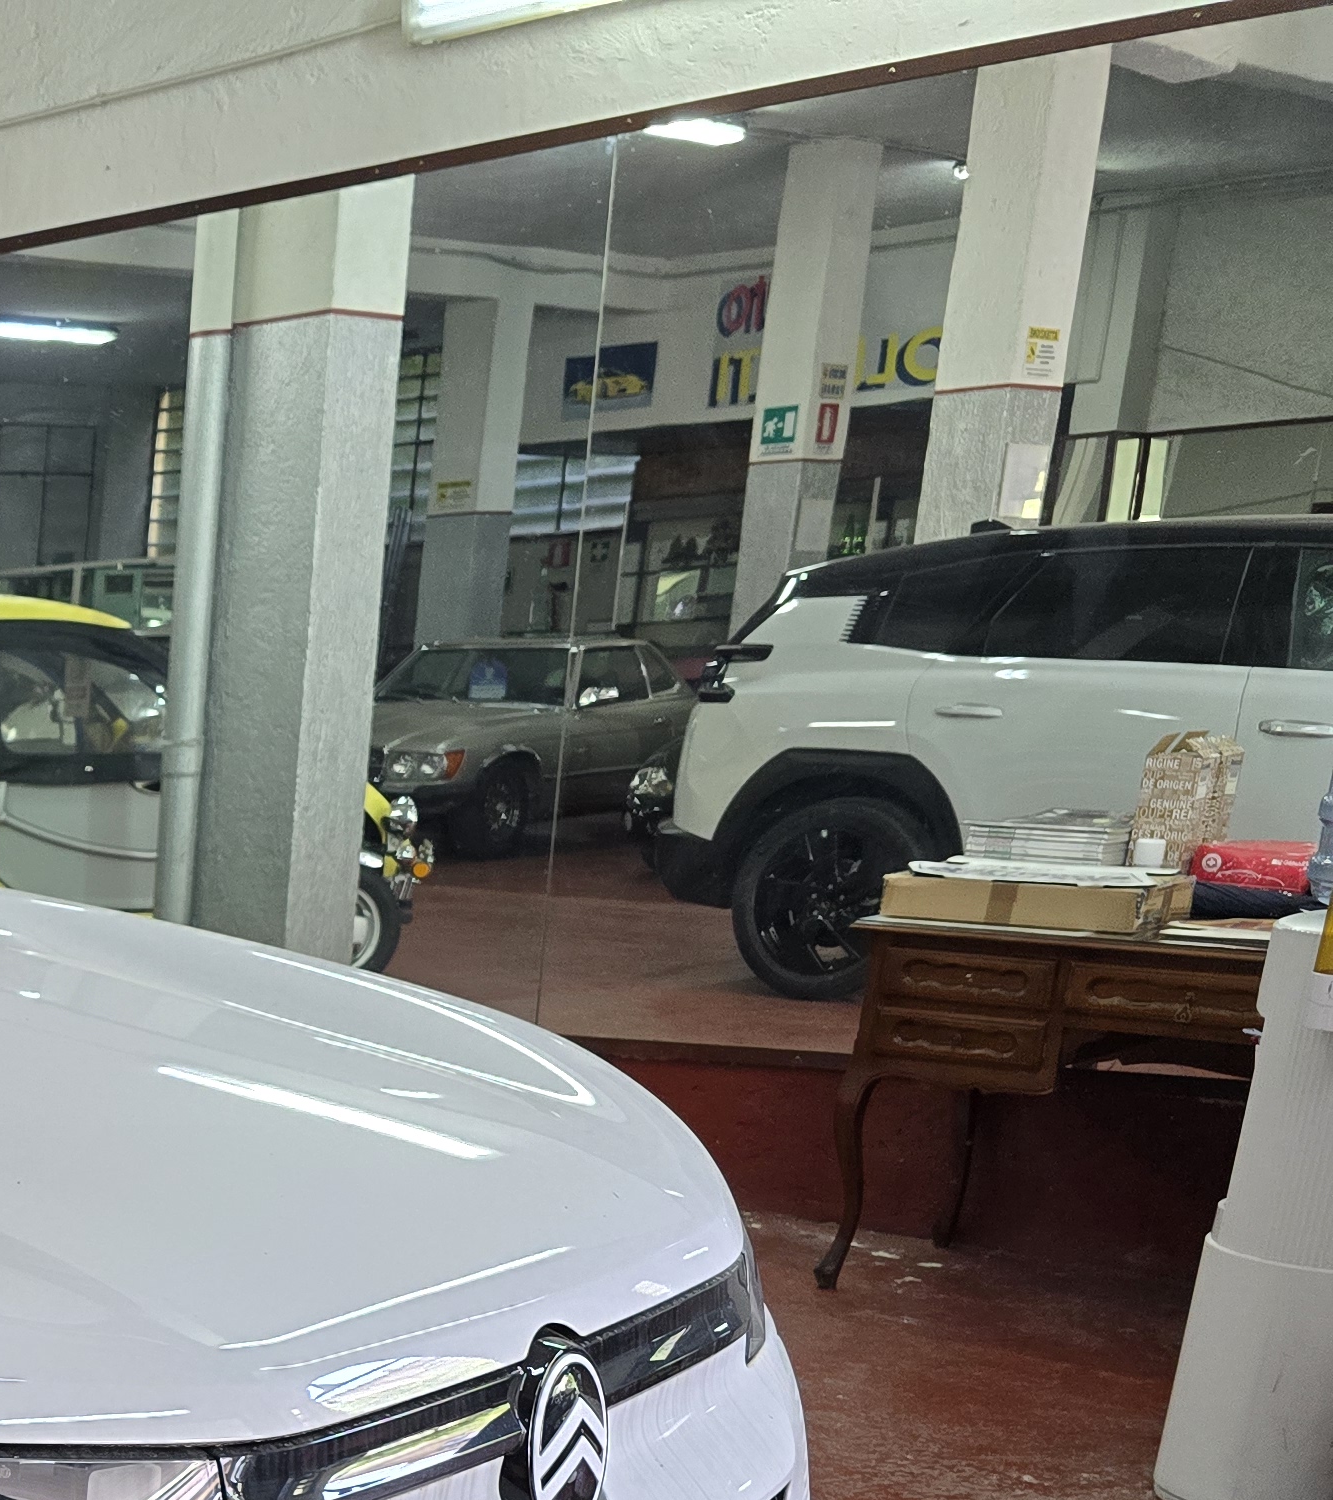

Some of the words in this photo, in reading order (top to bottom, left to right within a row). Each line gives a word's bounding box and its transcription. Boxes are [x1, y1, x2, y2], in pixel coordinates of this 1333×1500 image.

[1146, 758, 1181, 769] RIGINE
[1142, 778, 1155, 788] DE
[1156, 779, 1192, 790] ORIGEN
[1150, 799, 1193, 809] GENUINE
